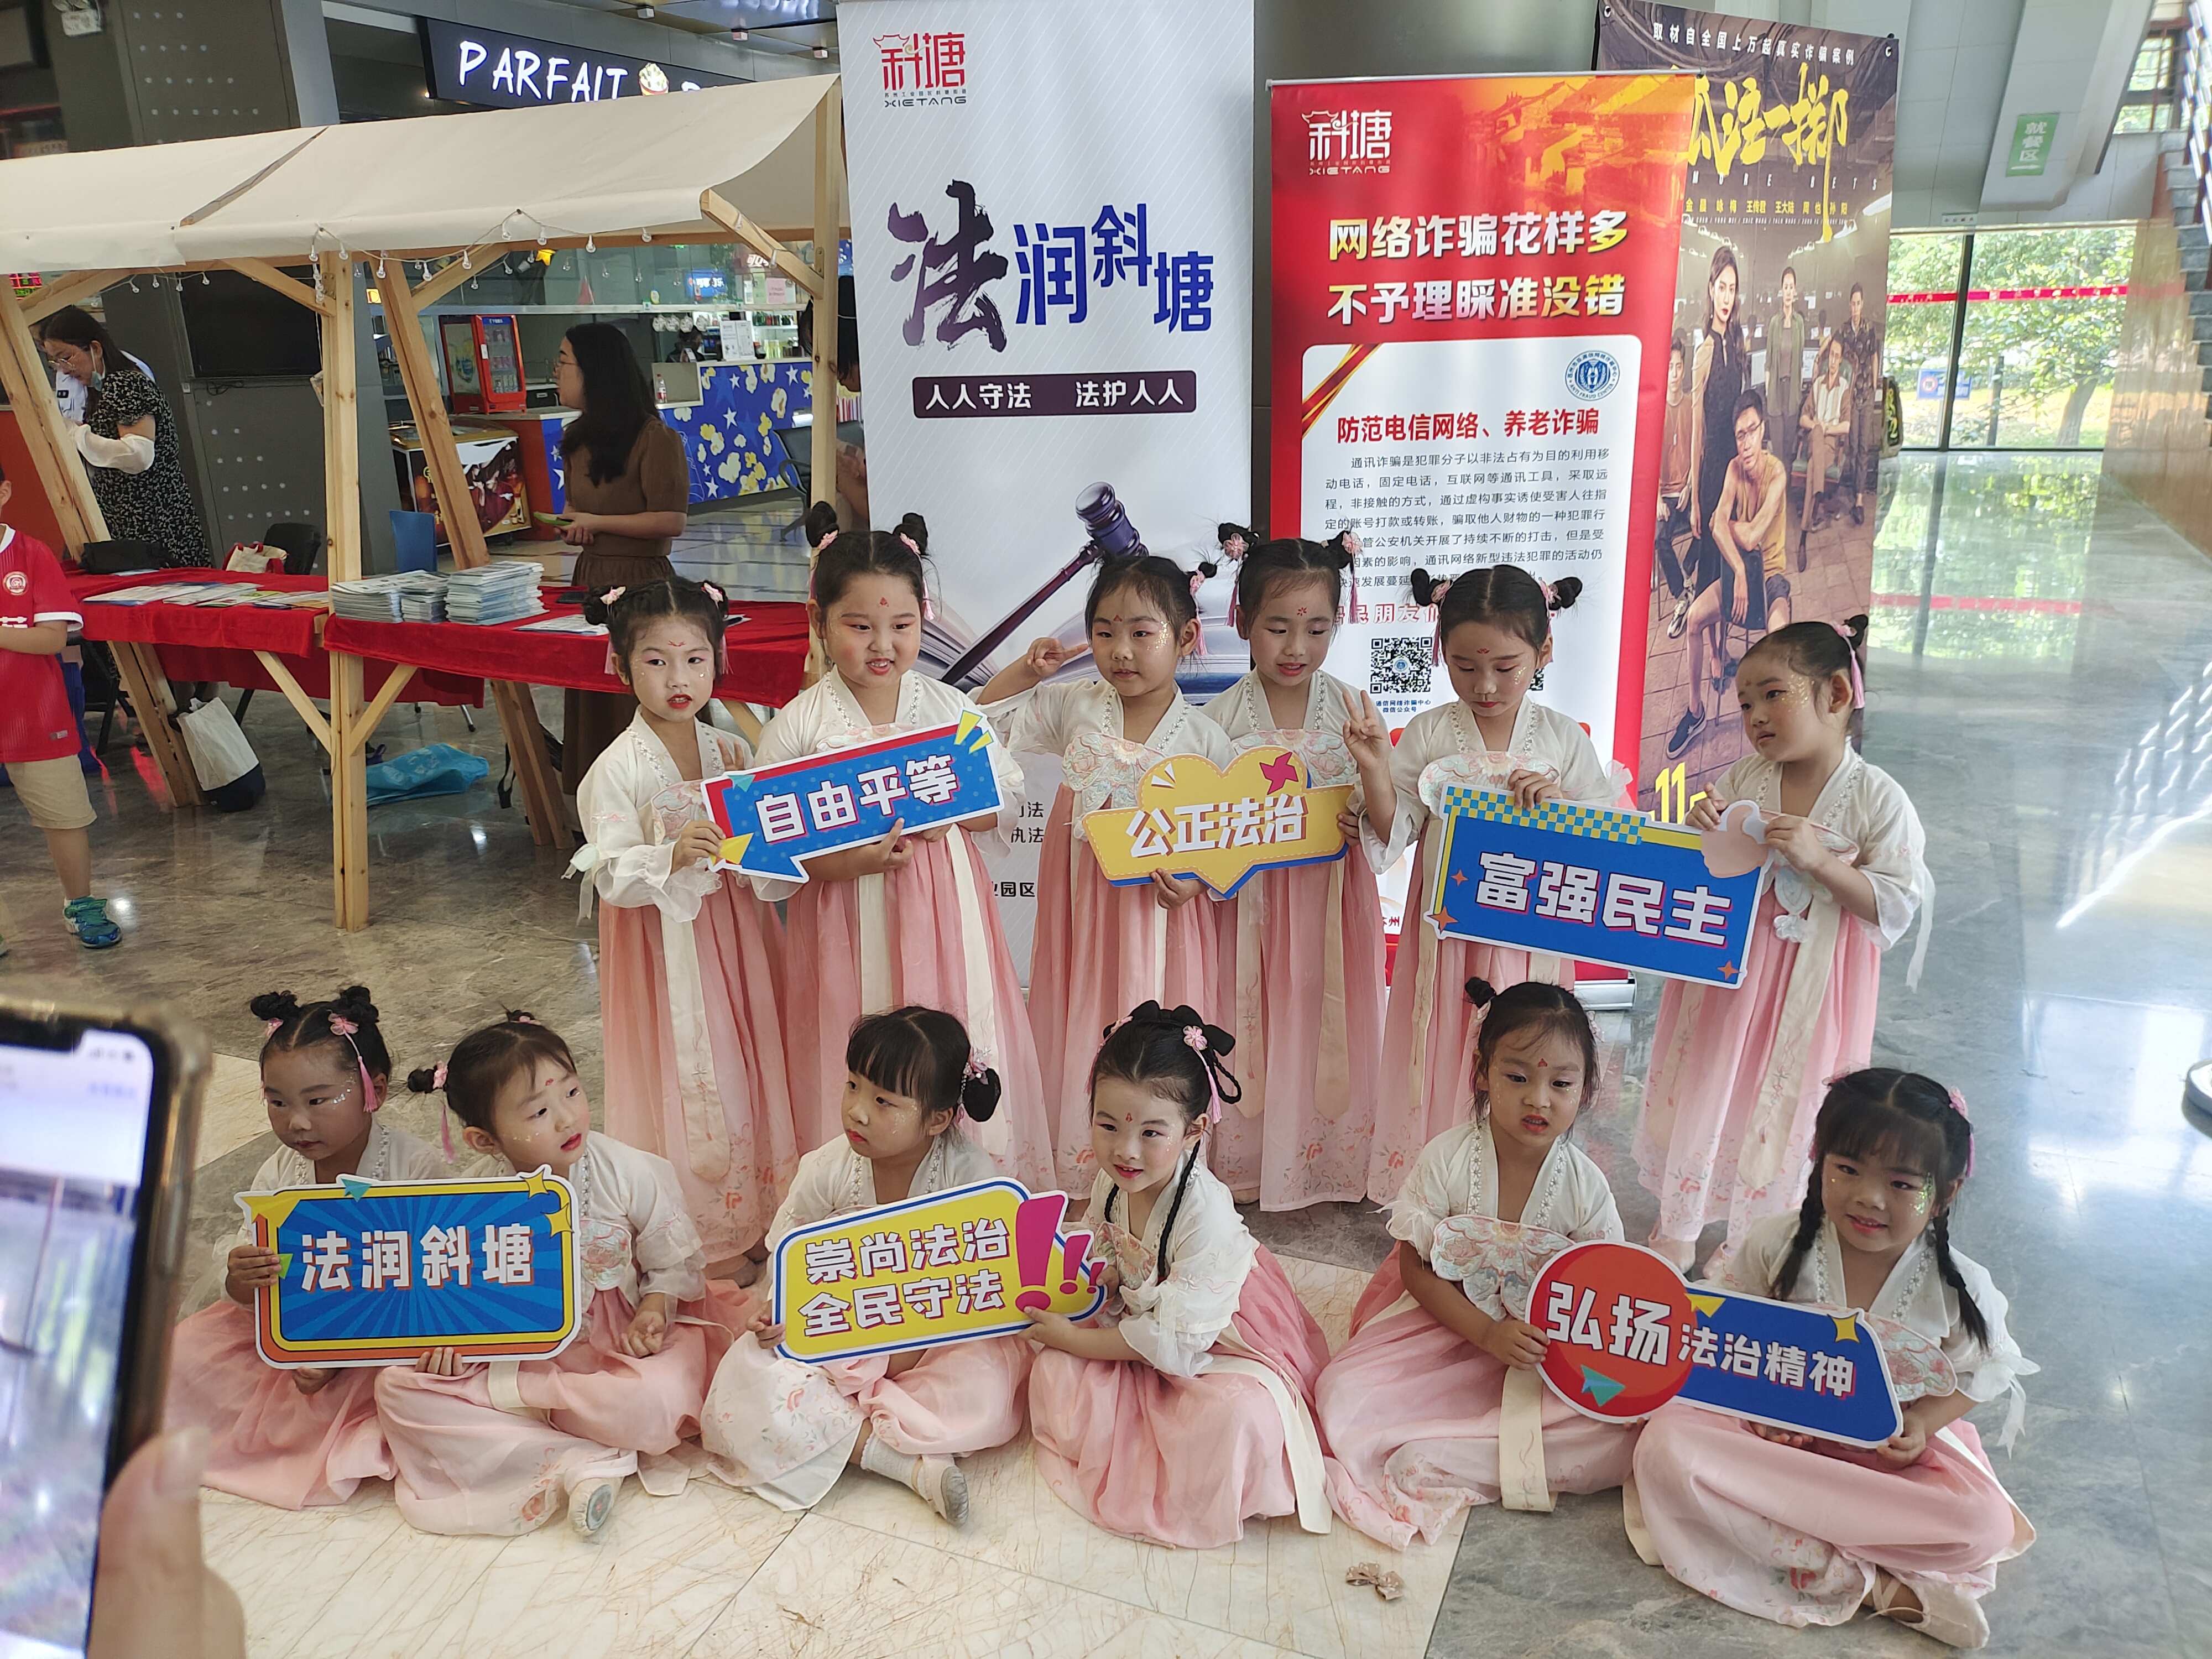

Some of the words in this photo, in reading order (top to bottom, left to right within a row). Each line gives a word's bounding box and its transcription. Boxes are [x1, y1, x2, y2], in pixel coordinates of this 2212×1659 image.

[1653, 22, 1855, 65] 取材自全国上万起真实诈骗案例
[459, 40, 628, 102] PARFAIT
[885, 96, 966, 108] XIETANG
[1309, 165, 1390, 176] XIETANG
[1329, 211, 1627, 261] 网络诈骗花样多
[1328, 274, 1625, 325] 不予理睬准没错
[925, 383, 1031, 410] 人人守法
[1076, 379, 1183, 408] 法护人人
[1338, 408, 1599, 443] 防范电信网络、养老诈骗
[1351, 448, 1610, 469] 通讯诈骗是犯罪分子以非法占有为目的利用移
[1358, 529, 1604, 549] 管公安机关开展了持续不断的打击，但是受
[755, 755, 960, 844] 自由平等
[1125, 793, 1308, 858] 公正法治
[1475, 851, 1733, 949] 富强民主
[301, 1223, 534, 1293] 法润斜塘
[805, 1218, 1011, 1285] 崇尚法治
[797, 1269, 1005, 1338] 全民守法
[1546, 1281, 1672, 1366] 弘扬
[1677, 1322, 1856, 1399] 法治精神
